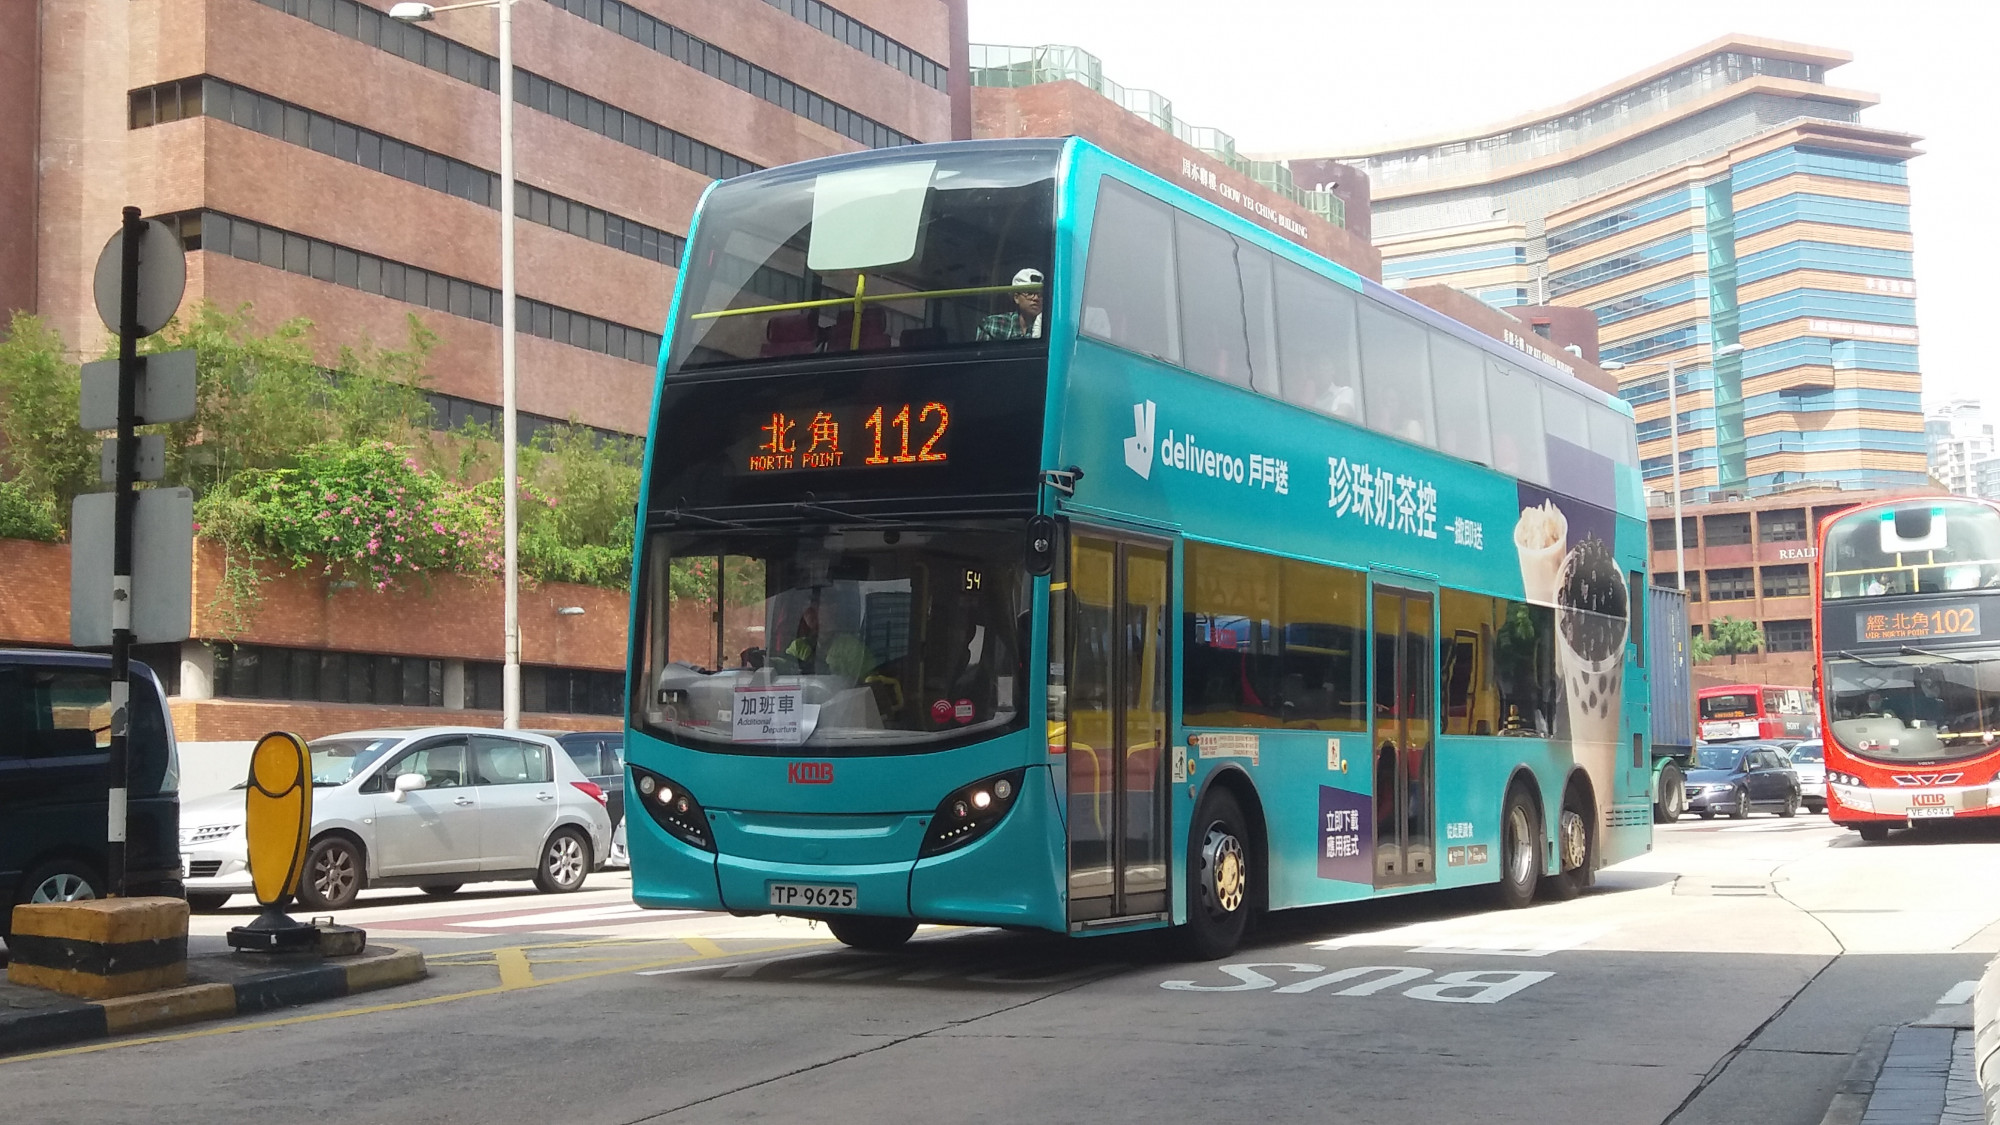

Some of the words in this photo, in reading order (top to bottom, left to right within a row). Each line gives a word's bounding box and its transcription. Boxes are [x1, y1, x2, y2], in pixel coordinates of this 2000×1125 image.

[1219, 183, 1241, 204] CHOW
[1242, 194, 1254, 211] YEI
[1255, 203, 1277, 224] CHING
[1278, 213, 1308, 239] BUILDING
[759, 410, 839, 453] 北角
[865, 401, 949, 465] 112
[750, 454, 794, 471] NORTH
[802, 451, 844, 468] POINT
[1161, 429, 1244, 484] deliveroo
[1328, 456, 1437, 540] 珍珠奶茶控
[966, 570, 981, 590] 54
[1931, 607, 1975, 634] 102
[1882, 630, 1906, 639] NORTH
[1907, 628, 1930, 637] POINT
[740, 694, 795, 715] 加班車
[737, 717, 772, 726] Additional
[762, 725, 797, 734] Departure
[788, 762, 834, 784] KMB
[1912, 793, 1946, 806] KMB
[1326, 810, 1359, 832] 立即下載
[1911, 808, 1923, 817] VE
[1326, 835, 1360, 858] 應用程式
[774, 886, 798, 904] TP
[804, 887, 853, 907] 9625
[1160, 962, 1556, 1004] BUS
